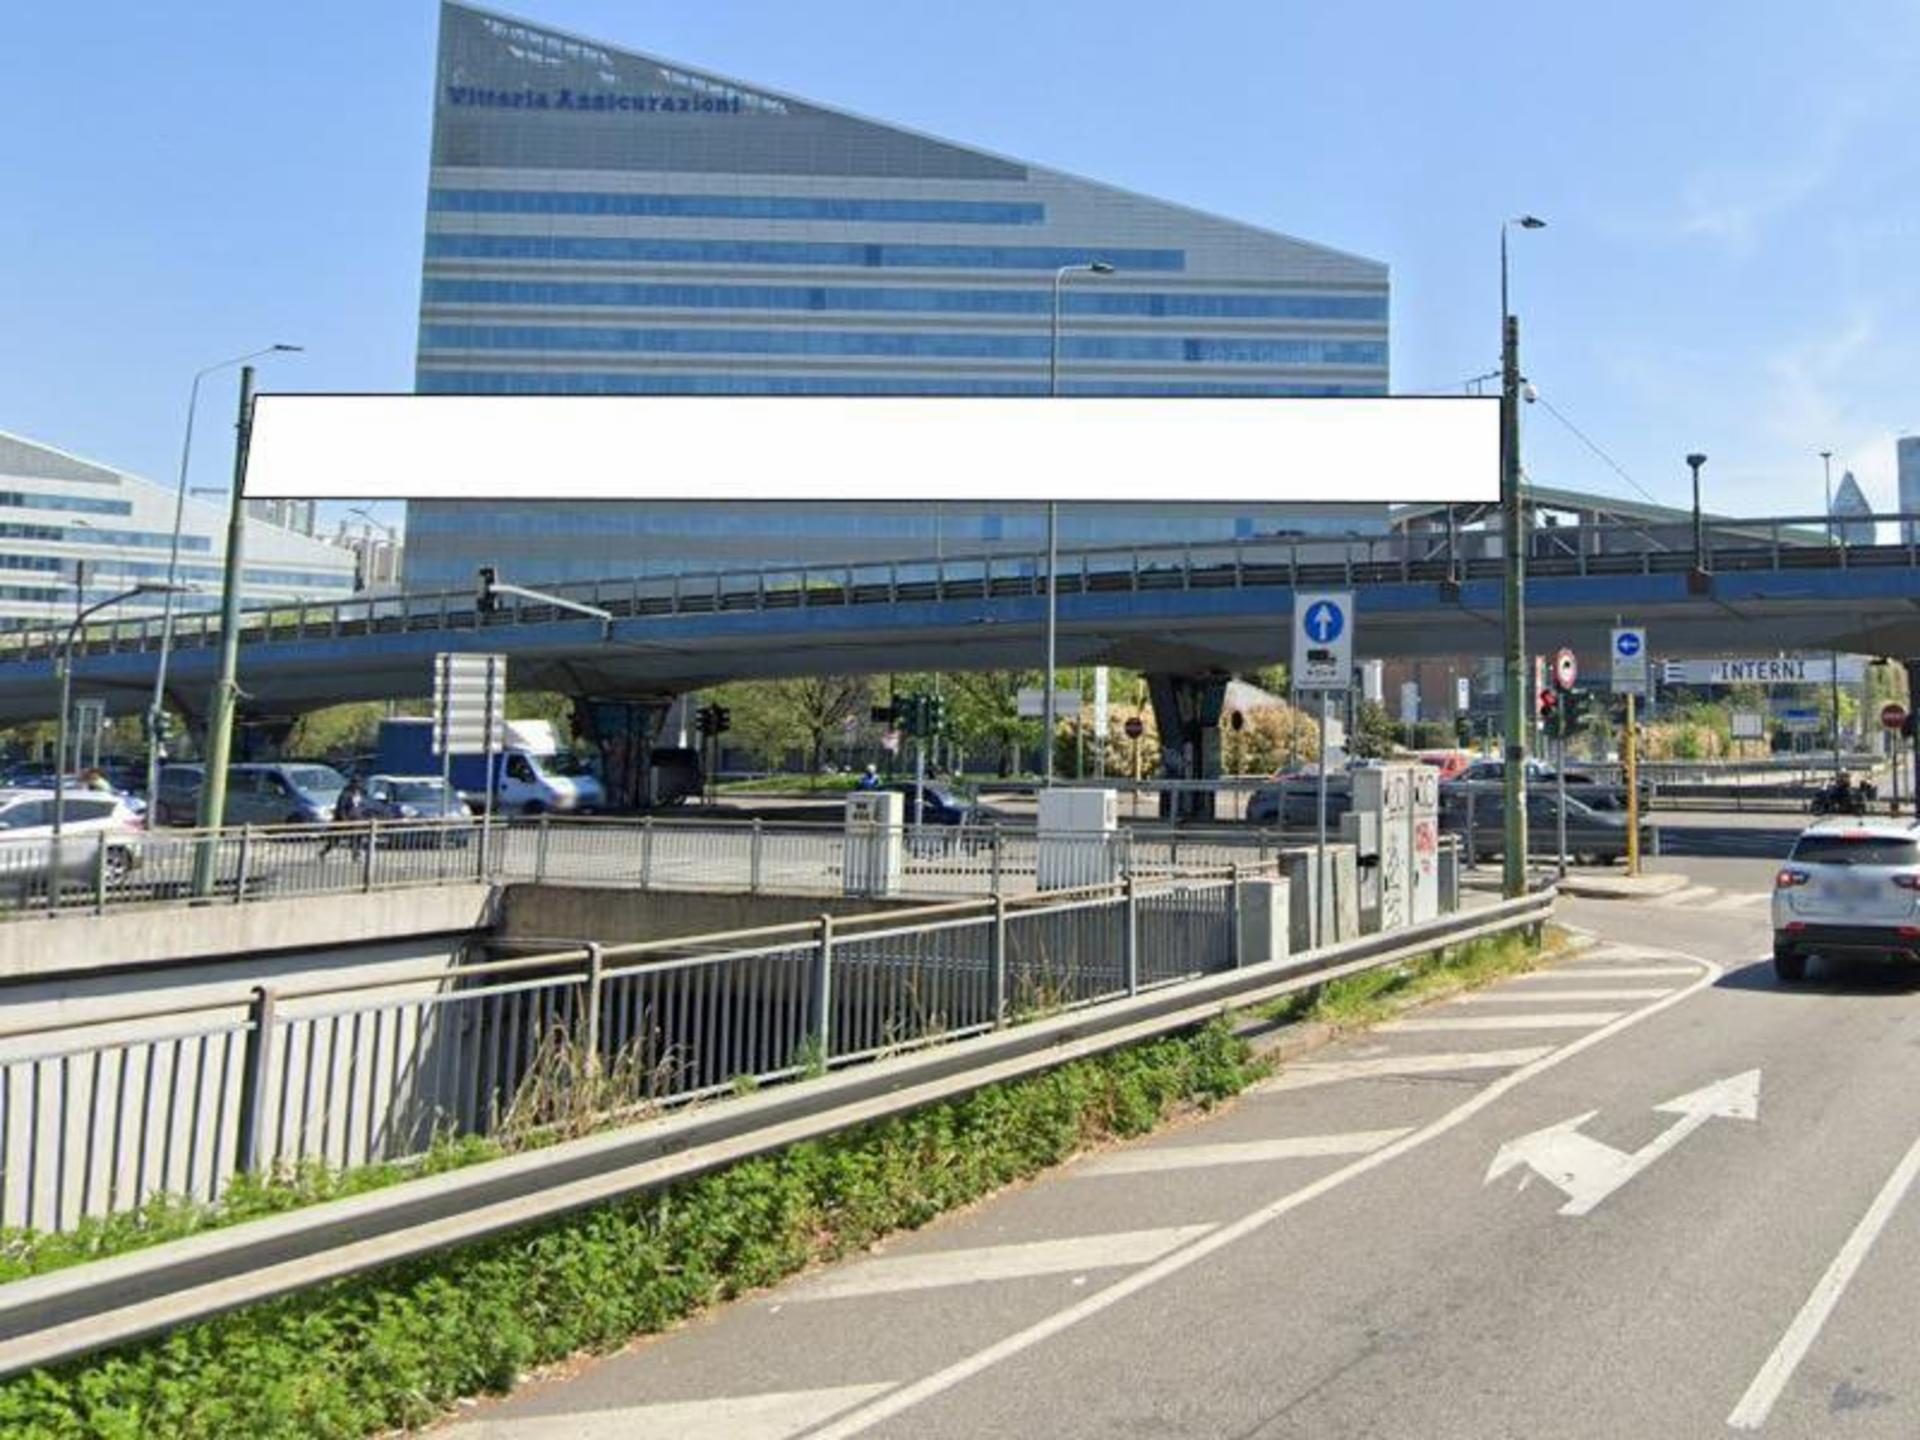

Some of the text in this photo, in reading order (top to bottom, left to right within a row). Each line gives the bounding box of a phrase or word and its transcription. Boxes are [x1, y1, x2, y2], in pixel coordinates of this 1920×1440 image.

[448, 87, 740, 114] Vittoria Assicurazioni
[1721, 662, 1806, 680] INTERNI
